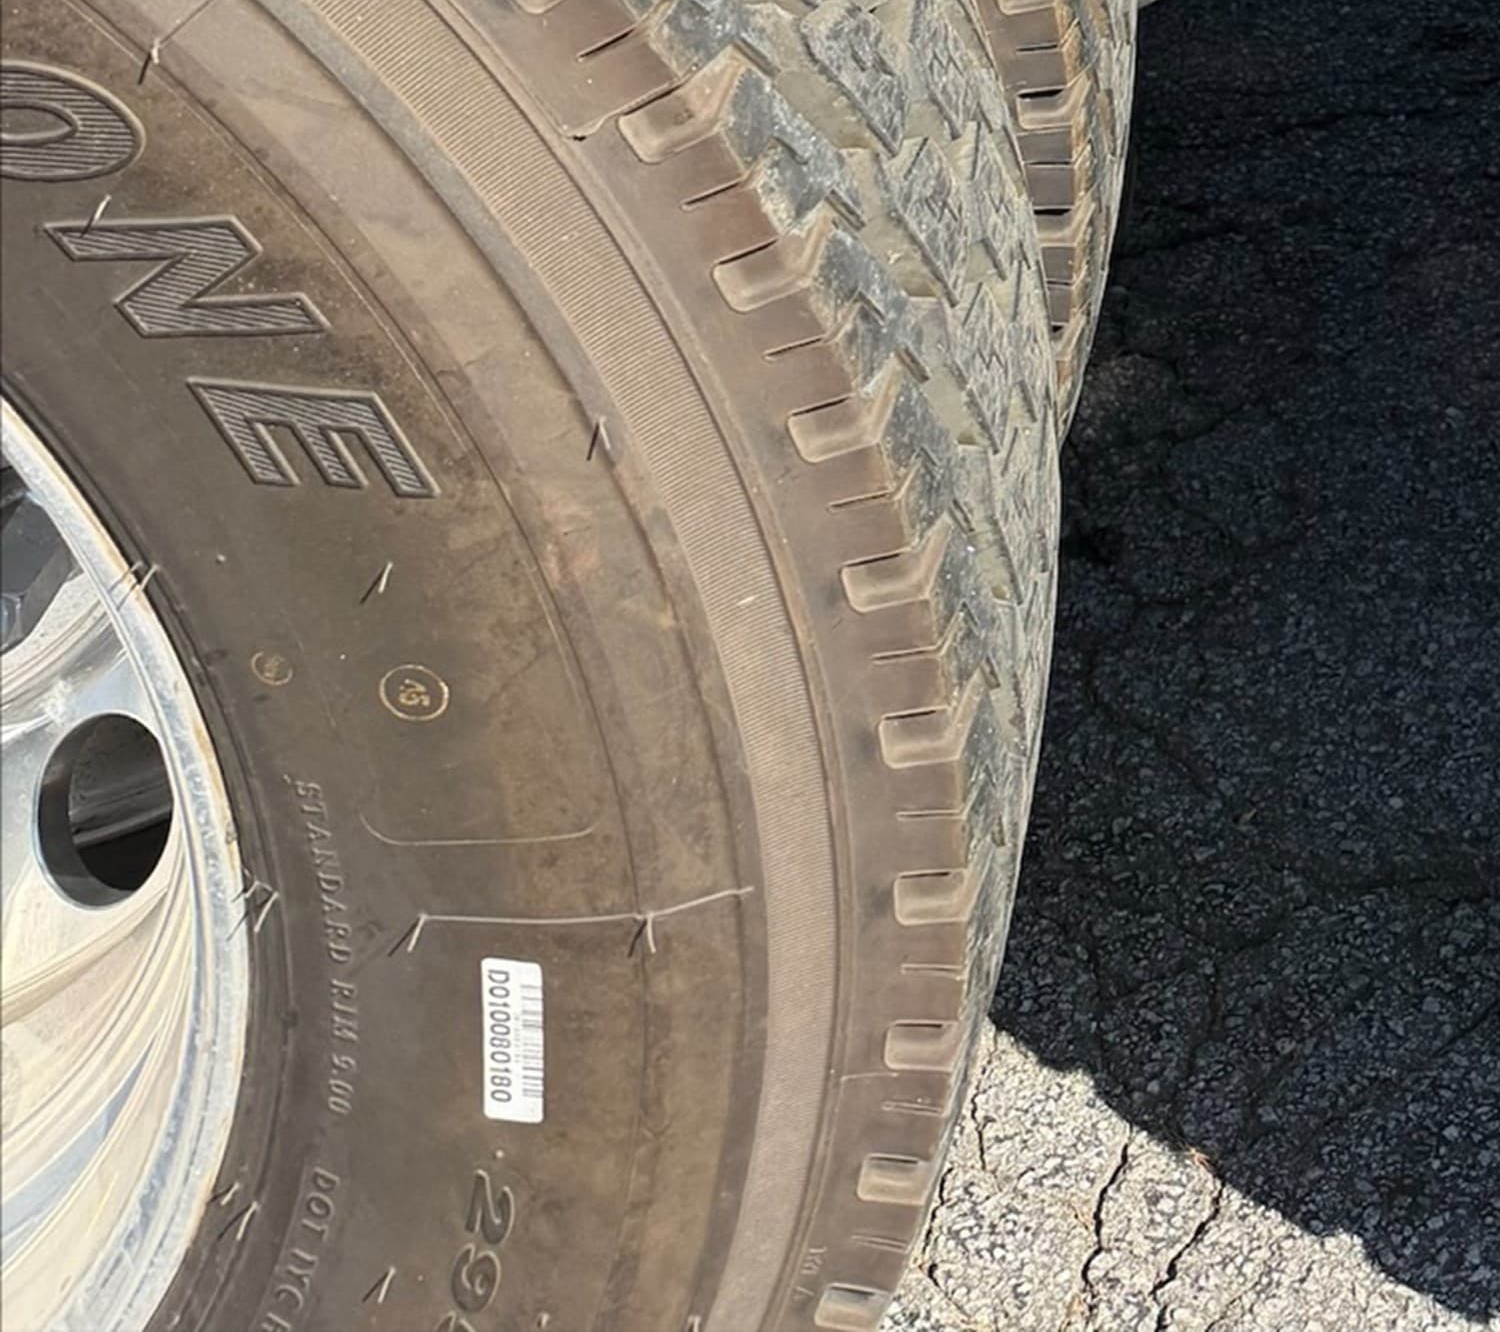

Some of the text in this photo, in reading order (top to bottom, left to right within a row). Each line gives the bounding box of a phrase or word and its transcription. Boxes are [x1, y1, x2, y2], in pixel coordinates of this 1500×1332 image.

[0, 59, 441, 498] ONE
[293, 779, 352, 965] STANDARD
[300, 1166, 341, 1244] DOT
